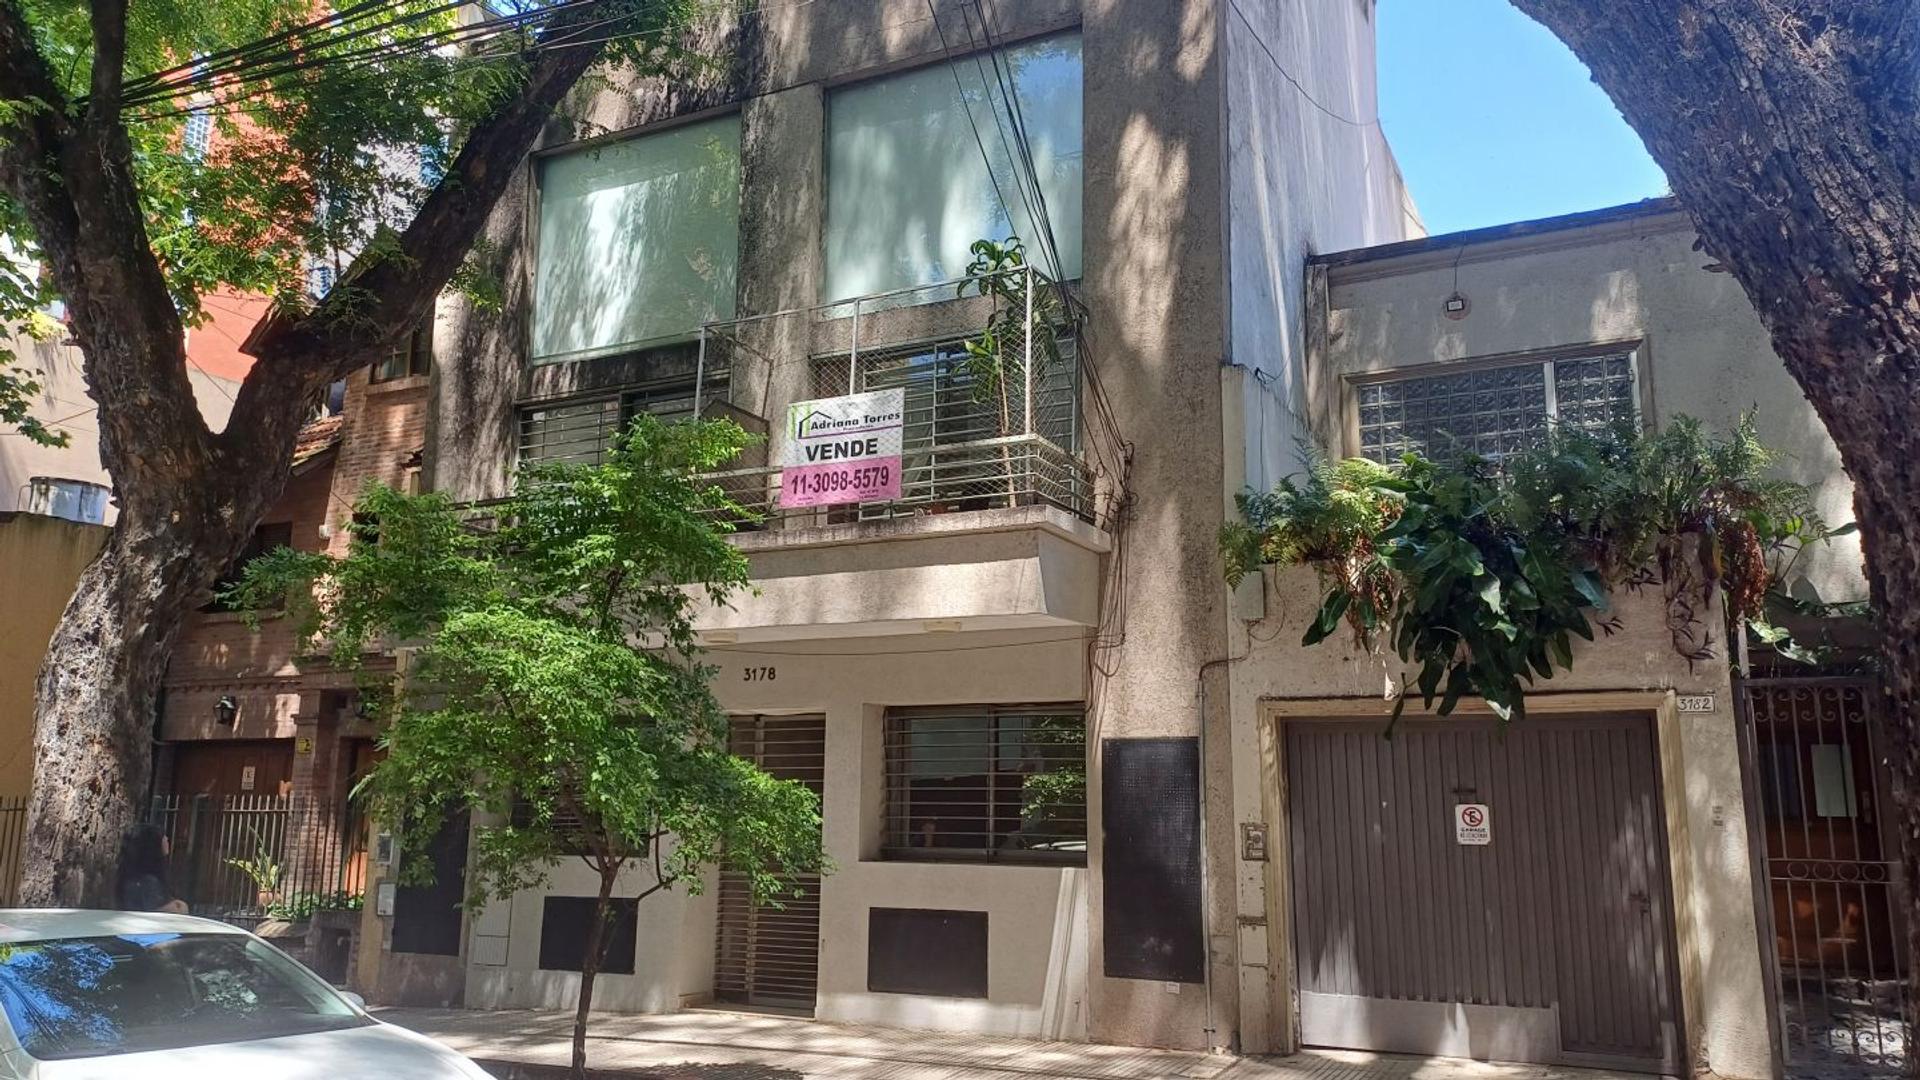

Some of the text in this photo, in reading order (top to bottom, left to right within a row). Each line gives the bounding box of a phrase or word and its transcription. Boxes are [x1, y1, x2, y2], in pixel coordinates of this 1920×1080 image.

[810, 418, 859, 430] Adriana
[864, 412, 900, 424] Torres
[805, 438, 878, 461] VENDE
[791, 465, 889, 494] 11-3098-5579
[743, 667, 776, 681] 3178
[1679, 698, 1711, 710] 3182
